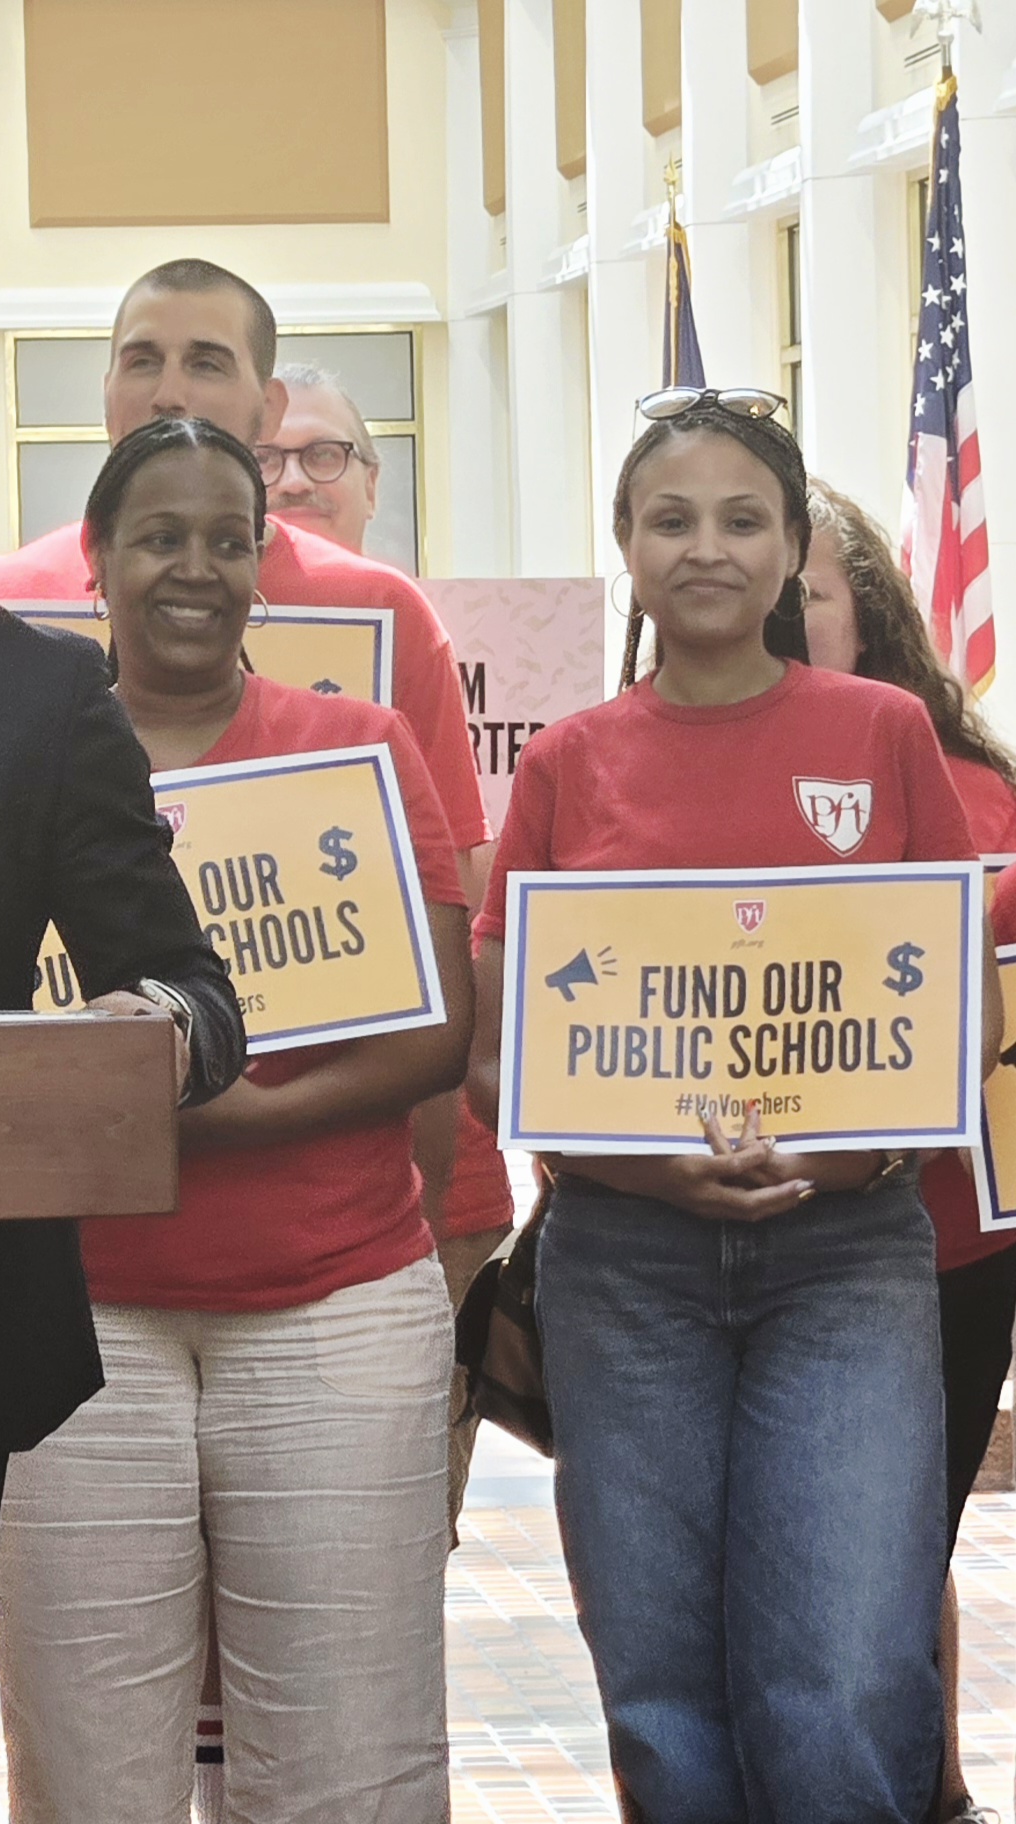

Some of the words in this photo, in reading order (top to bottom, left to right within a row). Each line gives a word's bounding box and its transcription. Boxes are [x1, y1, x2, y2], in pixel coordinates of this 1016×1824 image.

[198, 853, 285, 916] OUR
[640, 964, 747, 1020] FUND
[763, 961, 843, 1016] OUR
[567, 1024, 713, 1079] PUBLIC
[728, 1017, 914, 1079] SCHOOLS
